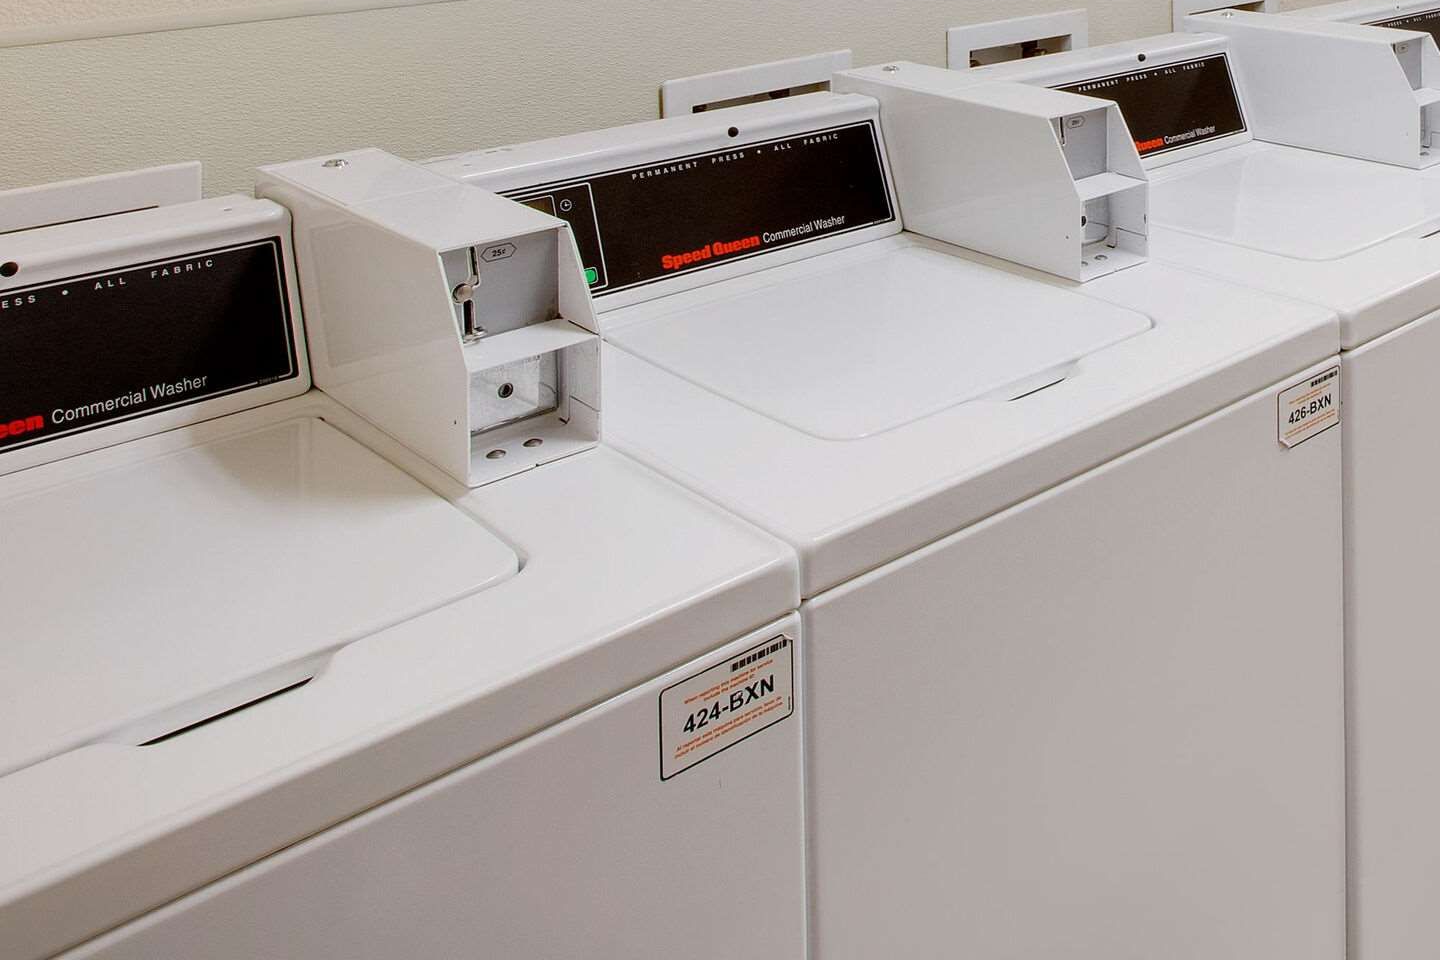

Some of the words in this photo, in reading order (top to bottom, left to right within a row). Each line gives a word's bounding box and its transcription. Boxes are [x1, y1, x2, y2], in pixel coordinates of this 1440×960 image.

[631, 161, 698, 180] PERMANENT
[711, 151, 745, 164] PRESS
[773, 142, 792, 152] ALL
[803, 133, 839, 145] FABRIC
[1164, 129, 1196, 144] Commercial
[1196, 125, 1216, 137] Washer
[661, 244, 712, 270] Speed
[713, 235, 761, 256] Queen
[762, 224, 813, 243] Commercial
[814, 214, 846, 231] Washer
[94, 278, 127, 290] ALL
[151, 259, 214, 279] FABRIC
[51, 388, 147, 425] Commercial
[150, 375, 208, 401] Washer
[1288, 393, 1332, 424] 426-BXN
[683, 674, 775, 734] 424-BXN
